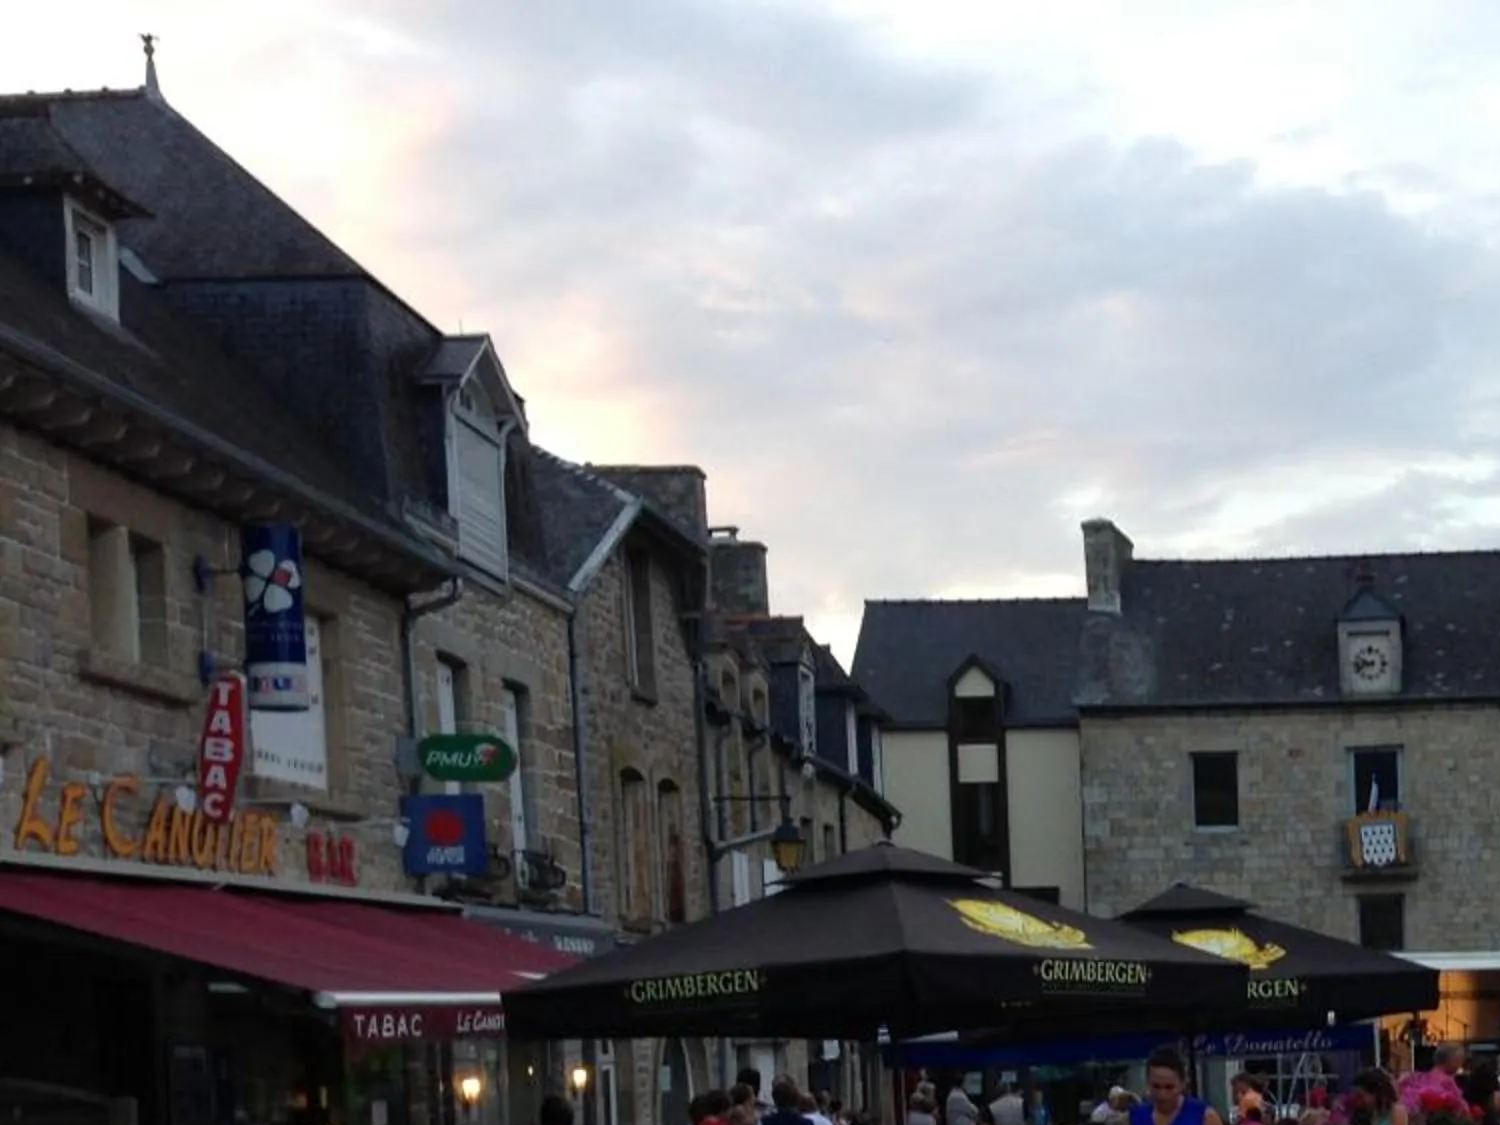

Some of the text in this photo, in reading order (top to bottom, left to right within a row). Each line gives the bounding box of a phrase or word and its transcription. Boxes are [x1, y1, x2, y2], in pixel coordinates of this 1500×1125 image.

[203, 681, 235, 819] TABAC
[426, 750, 472, 768] PMU
[1039, 958, 1147, 985] GRIMBERGEN
[630, 969, 759, 1003] GRIMBERGEN
[353, 1013, 424, 1039] TABAC
[1224, 1029, 1333, 1054] Donatello
